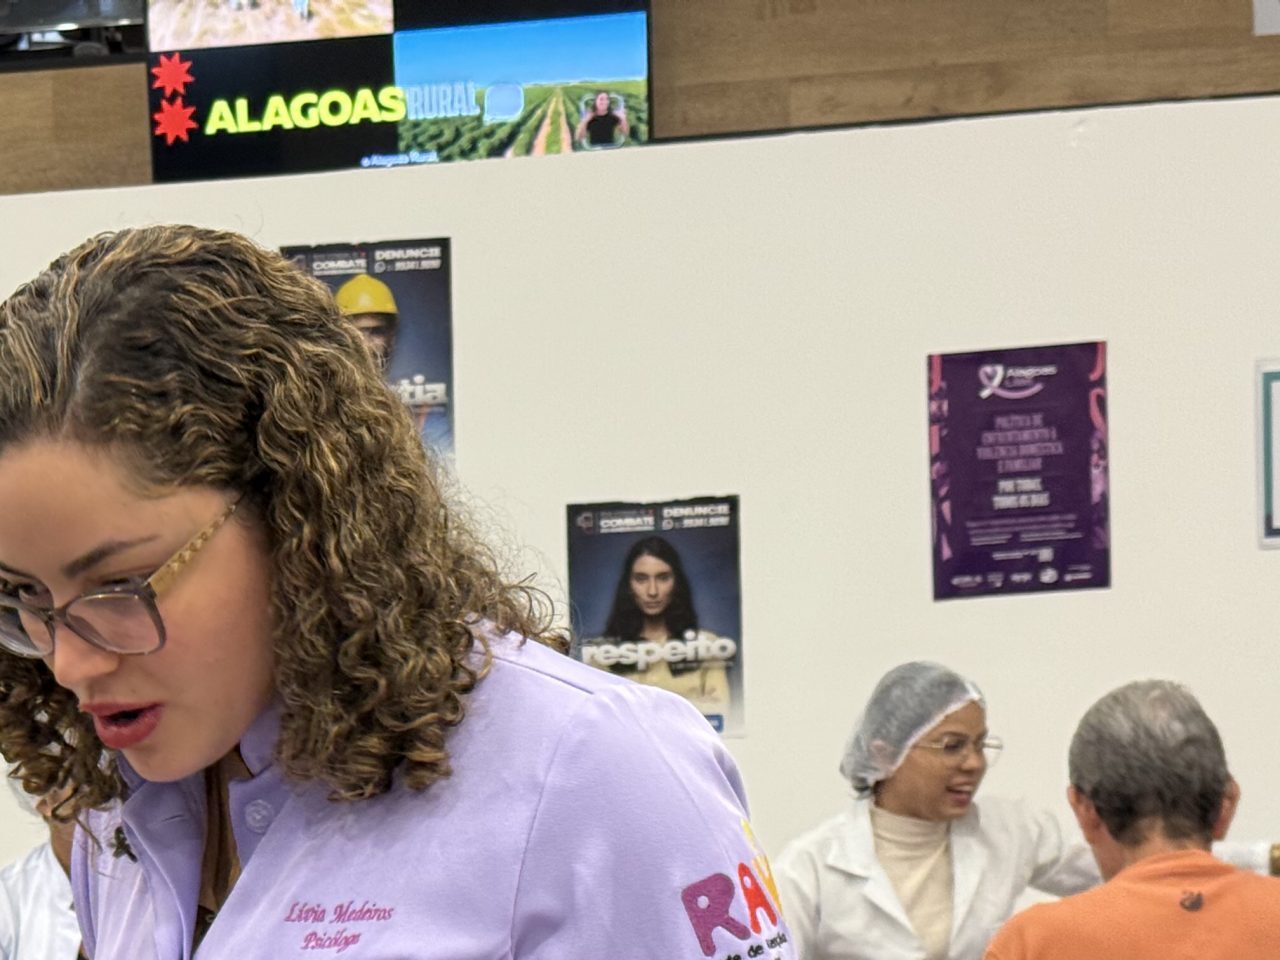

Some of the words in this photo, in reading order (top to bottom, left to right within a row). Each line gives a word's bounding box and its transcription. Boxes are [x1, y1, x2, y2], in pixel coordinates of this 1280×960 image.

[205, 85, 407, 135] ALAGOAS
[407, 82, 480, 120] RURAL
[374, 246, 442, 261] DENUNCIE
[312, 258, 368, 271] COMBATE
[662, 502, 730, 518] DENUNCIE
[599, 515, 655, 529] COMBATE
[581, 628, 737, 672] respeito
[329, 900, 395, 923] Medeiros
[747, 944, 764, 958] de
